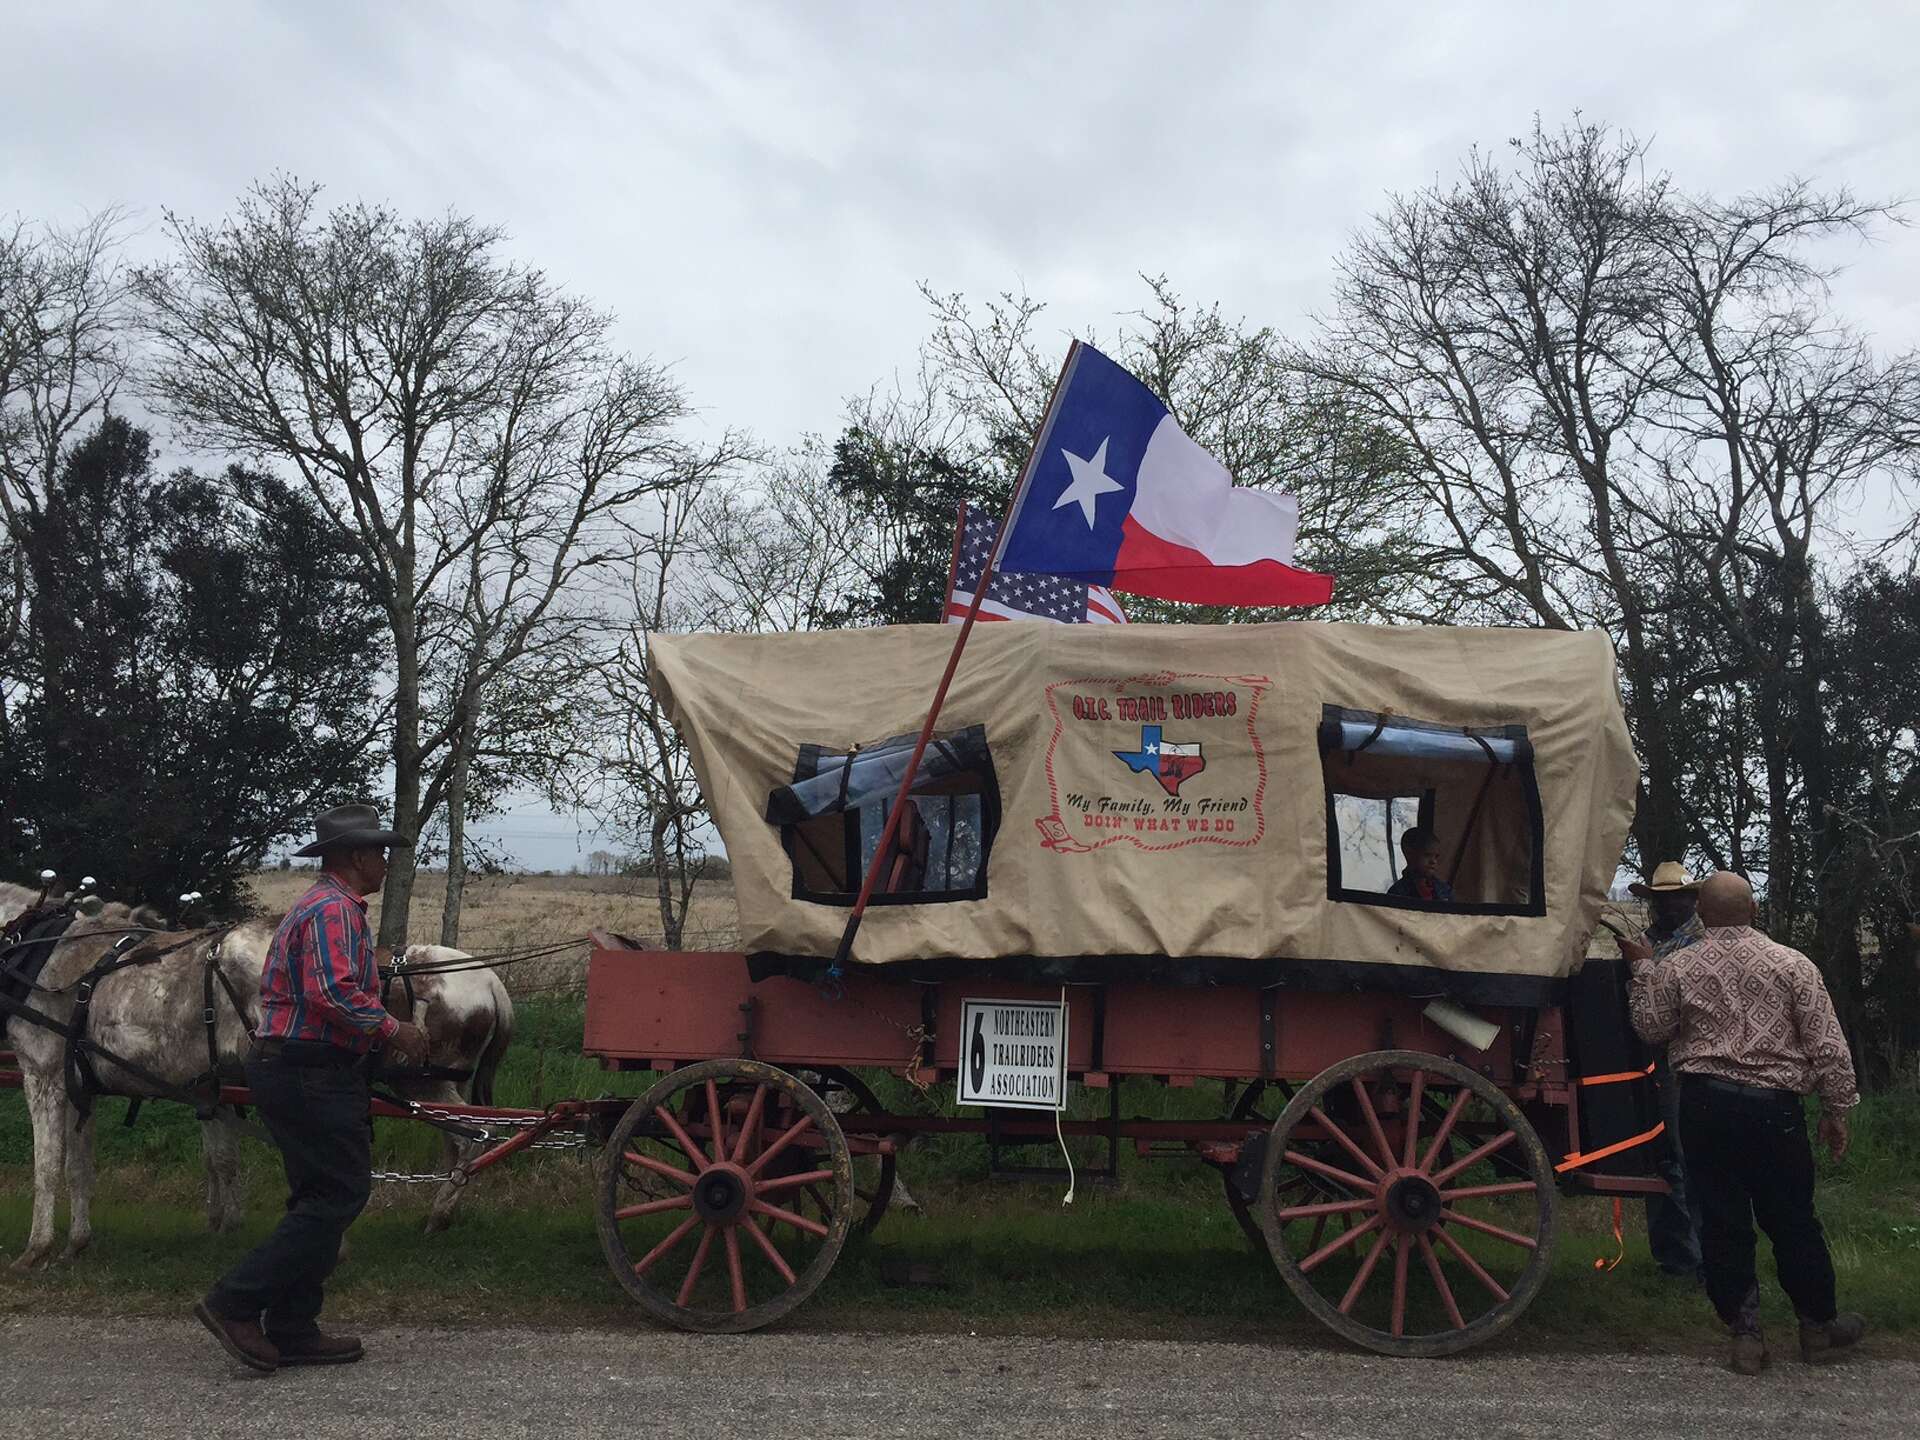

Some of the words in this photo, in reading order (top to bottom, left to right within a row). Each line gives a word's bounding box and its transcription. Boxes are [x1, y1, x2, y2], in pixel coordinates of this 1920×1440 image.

[1116, 695, 1168, 722] TRAIL
[1171, 691, 1237, 720] RIDERS
[1098, 797, 1154, 816] Family,
[1163, 798, 1191, 816] My
[1197, 796, 1248, 815] Friend
[1134, 817, 1181, 832] WHAT
[1187, 818, 1209, 833] WE
[1215, 818, 1234, 833] DO
[993, 1009, 1055, 1038] NORTHEASTERN
[970, 1012, 985, 1094] 6
[993, 1043, 1055, 1068] TRAILRIDERS
[990, 1073, 1055, 1098] ASSOCIATION
